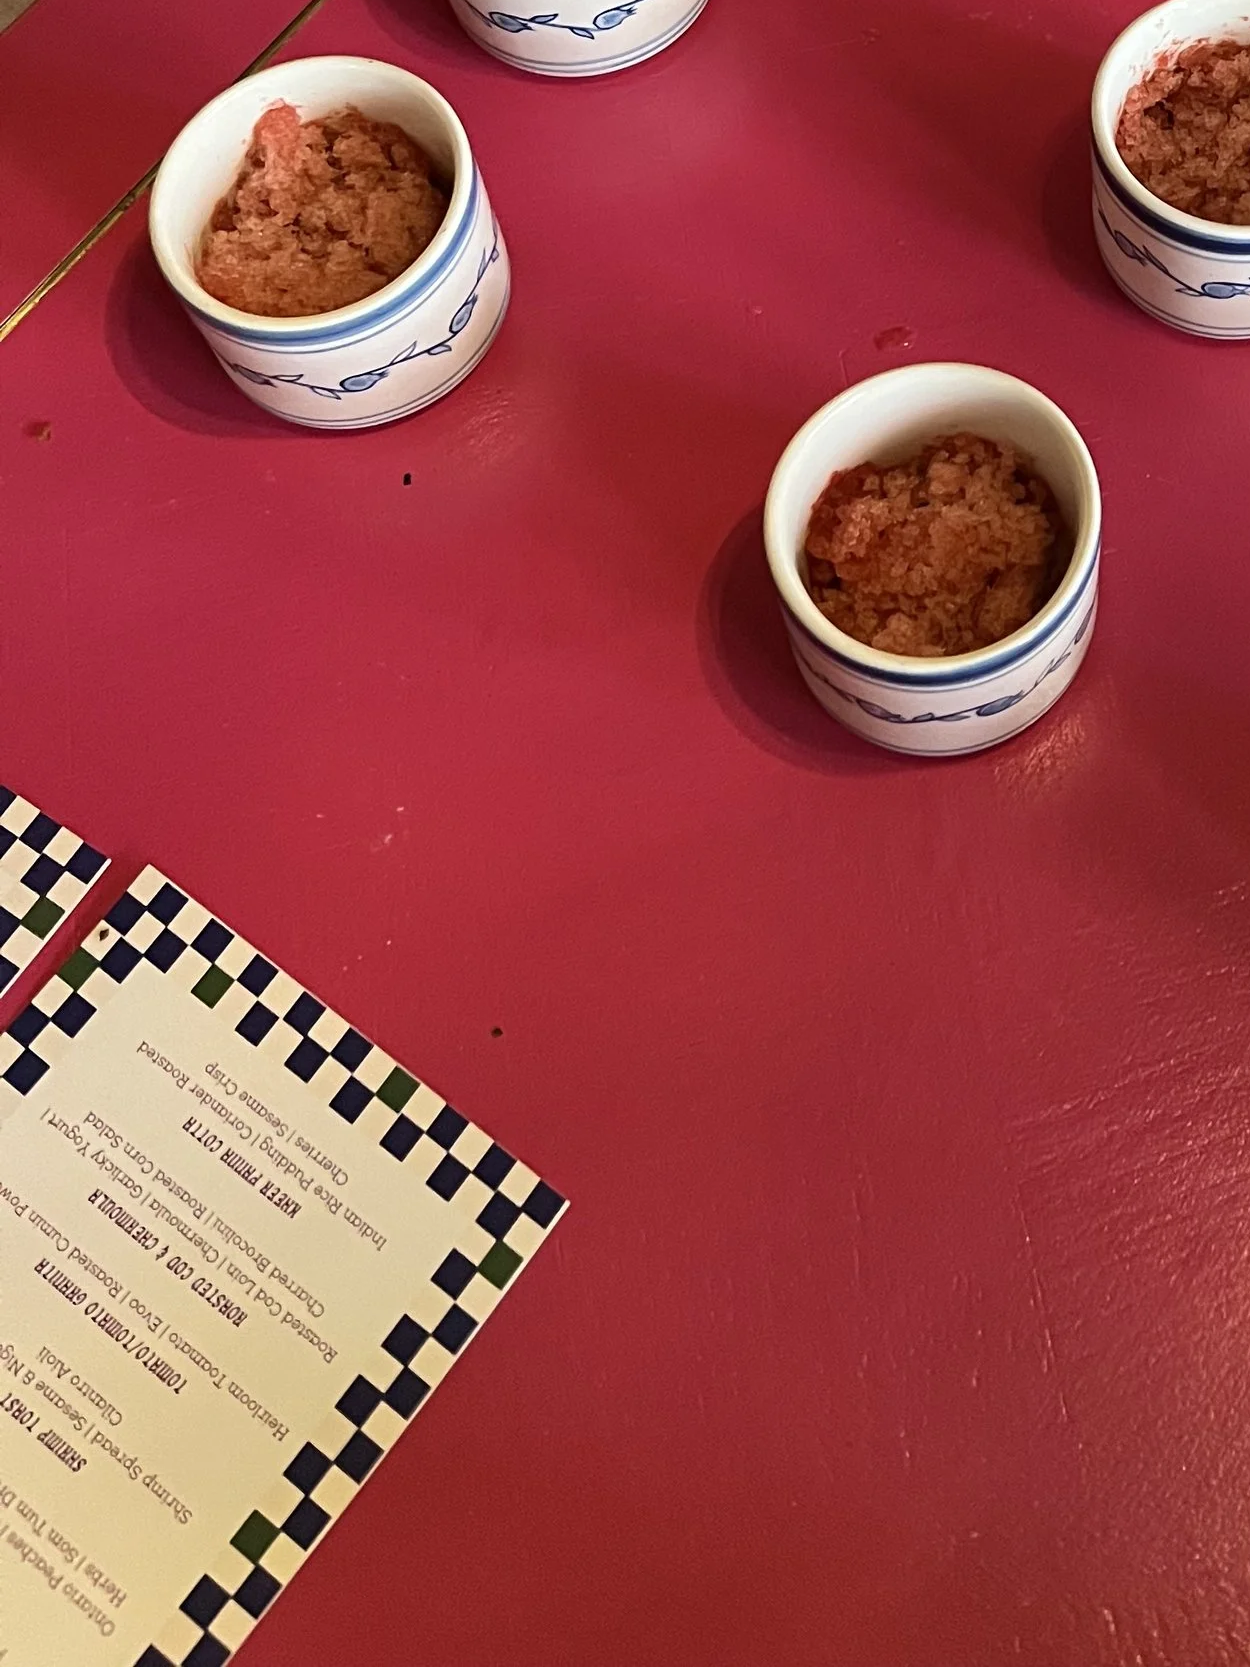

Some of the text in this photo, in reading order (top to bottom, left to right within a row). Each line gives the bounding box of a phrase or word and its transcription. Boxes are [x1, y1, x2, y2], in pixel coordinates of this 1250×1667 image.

[135, 1039, 388, 1253] Indian Rice Pudding Coriander Roasted
[182, 1115, 225, 1154] COTTA
[203, 1061, 350, 1187] Cherries Sesame Crisp
[46, 1112, 340, 1365] Roasted Cod Loin Chermoula Garlicky Yogurt
[81, 1109, 326, 1320] Charred Brocolini Roasted Corn Salad
[88, 1187, 161, 1252] CHERMOULA
[164, 1255, 195, 1282] COD
[0, 1181, 291, 1443] Heirloom Toamato Evoo Roasted Cumin Pow
[189, 1276, 249, 1329] ROASTED
[0, 1342, 26, 1379] Nig
[35, 1344, 124, 1428] Cilantro Aioli
[34, 1379, 89, 1433] Sesame
[35, 1428, 89, 1474] SHRIMP
[89, 1429, 144, 1482] Spread
[15, 1498, 48, 1539] Tum
[141, 1472, 194, 1526] Shrimp
[46, 1526, 80, 1565] Som
[61, 1581, 117, 1638] Ontario
